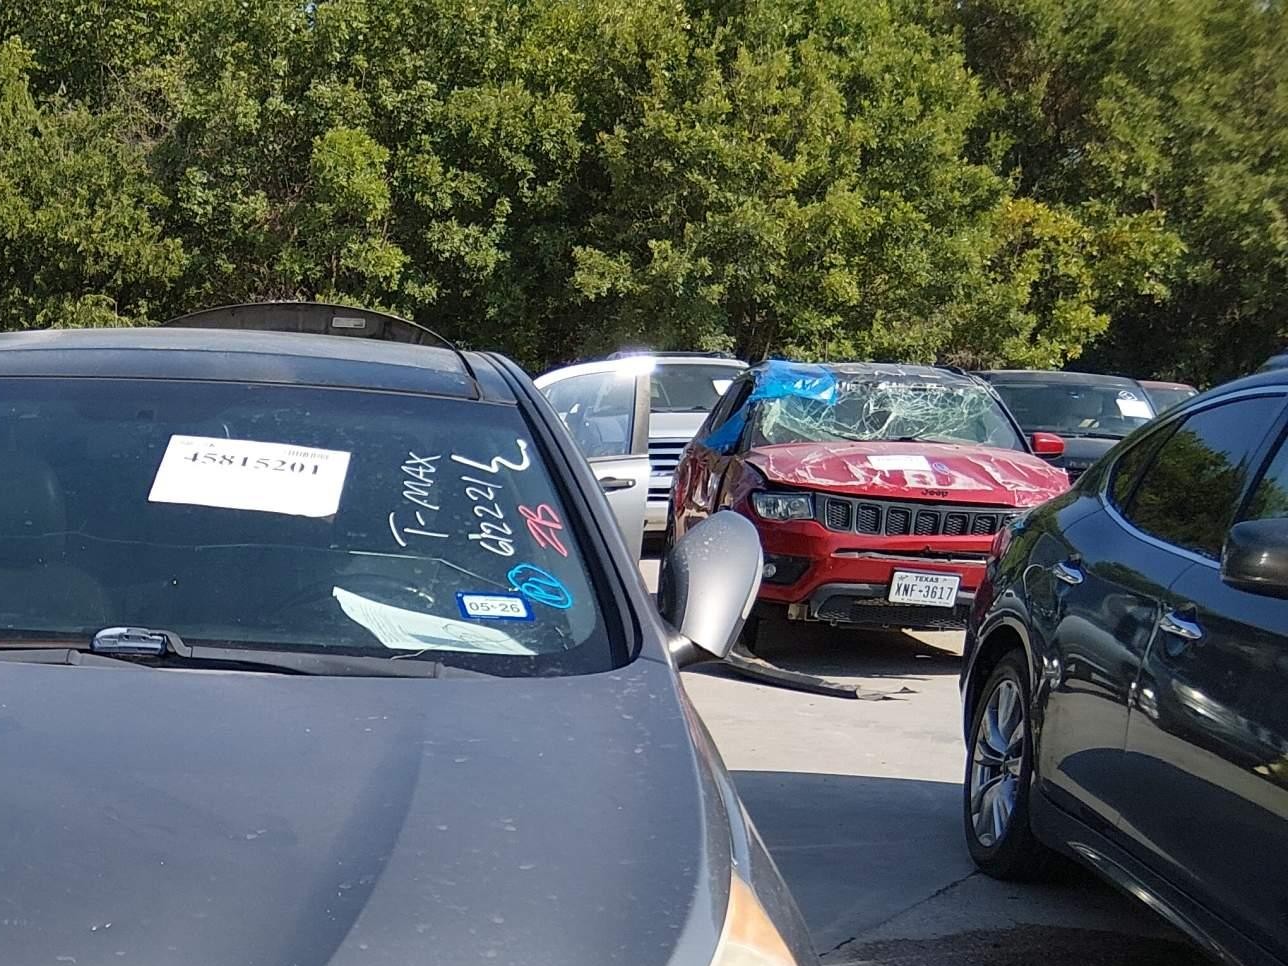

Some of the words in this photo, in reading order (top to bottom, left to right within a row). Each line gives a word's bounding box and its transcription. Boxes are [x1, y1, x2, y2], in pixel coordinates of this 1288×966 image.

[184, 451, 320, 475] 45815201
[921, 489, 949, 497] Jeep
[914, 575, 940, 583] TEXAS
[894, 582, 954, 601] XNF-3617
